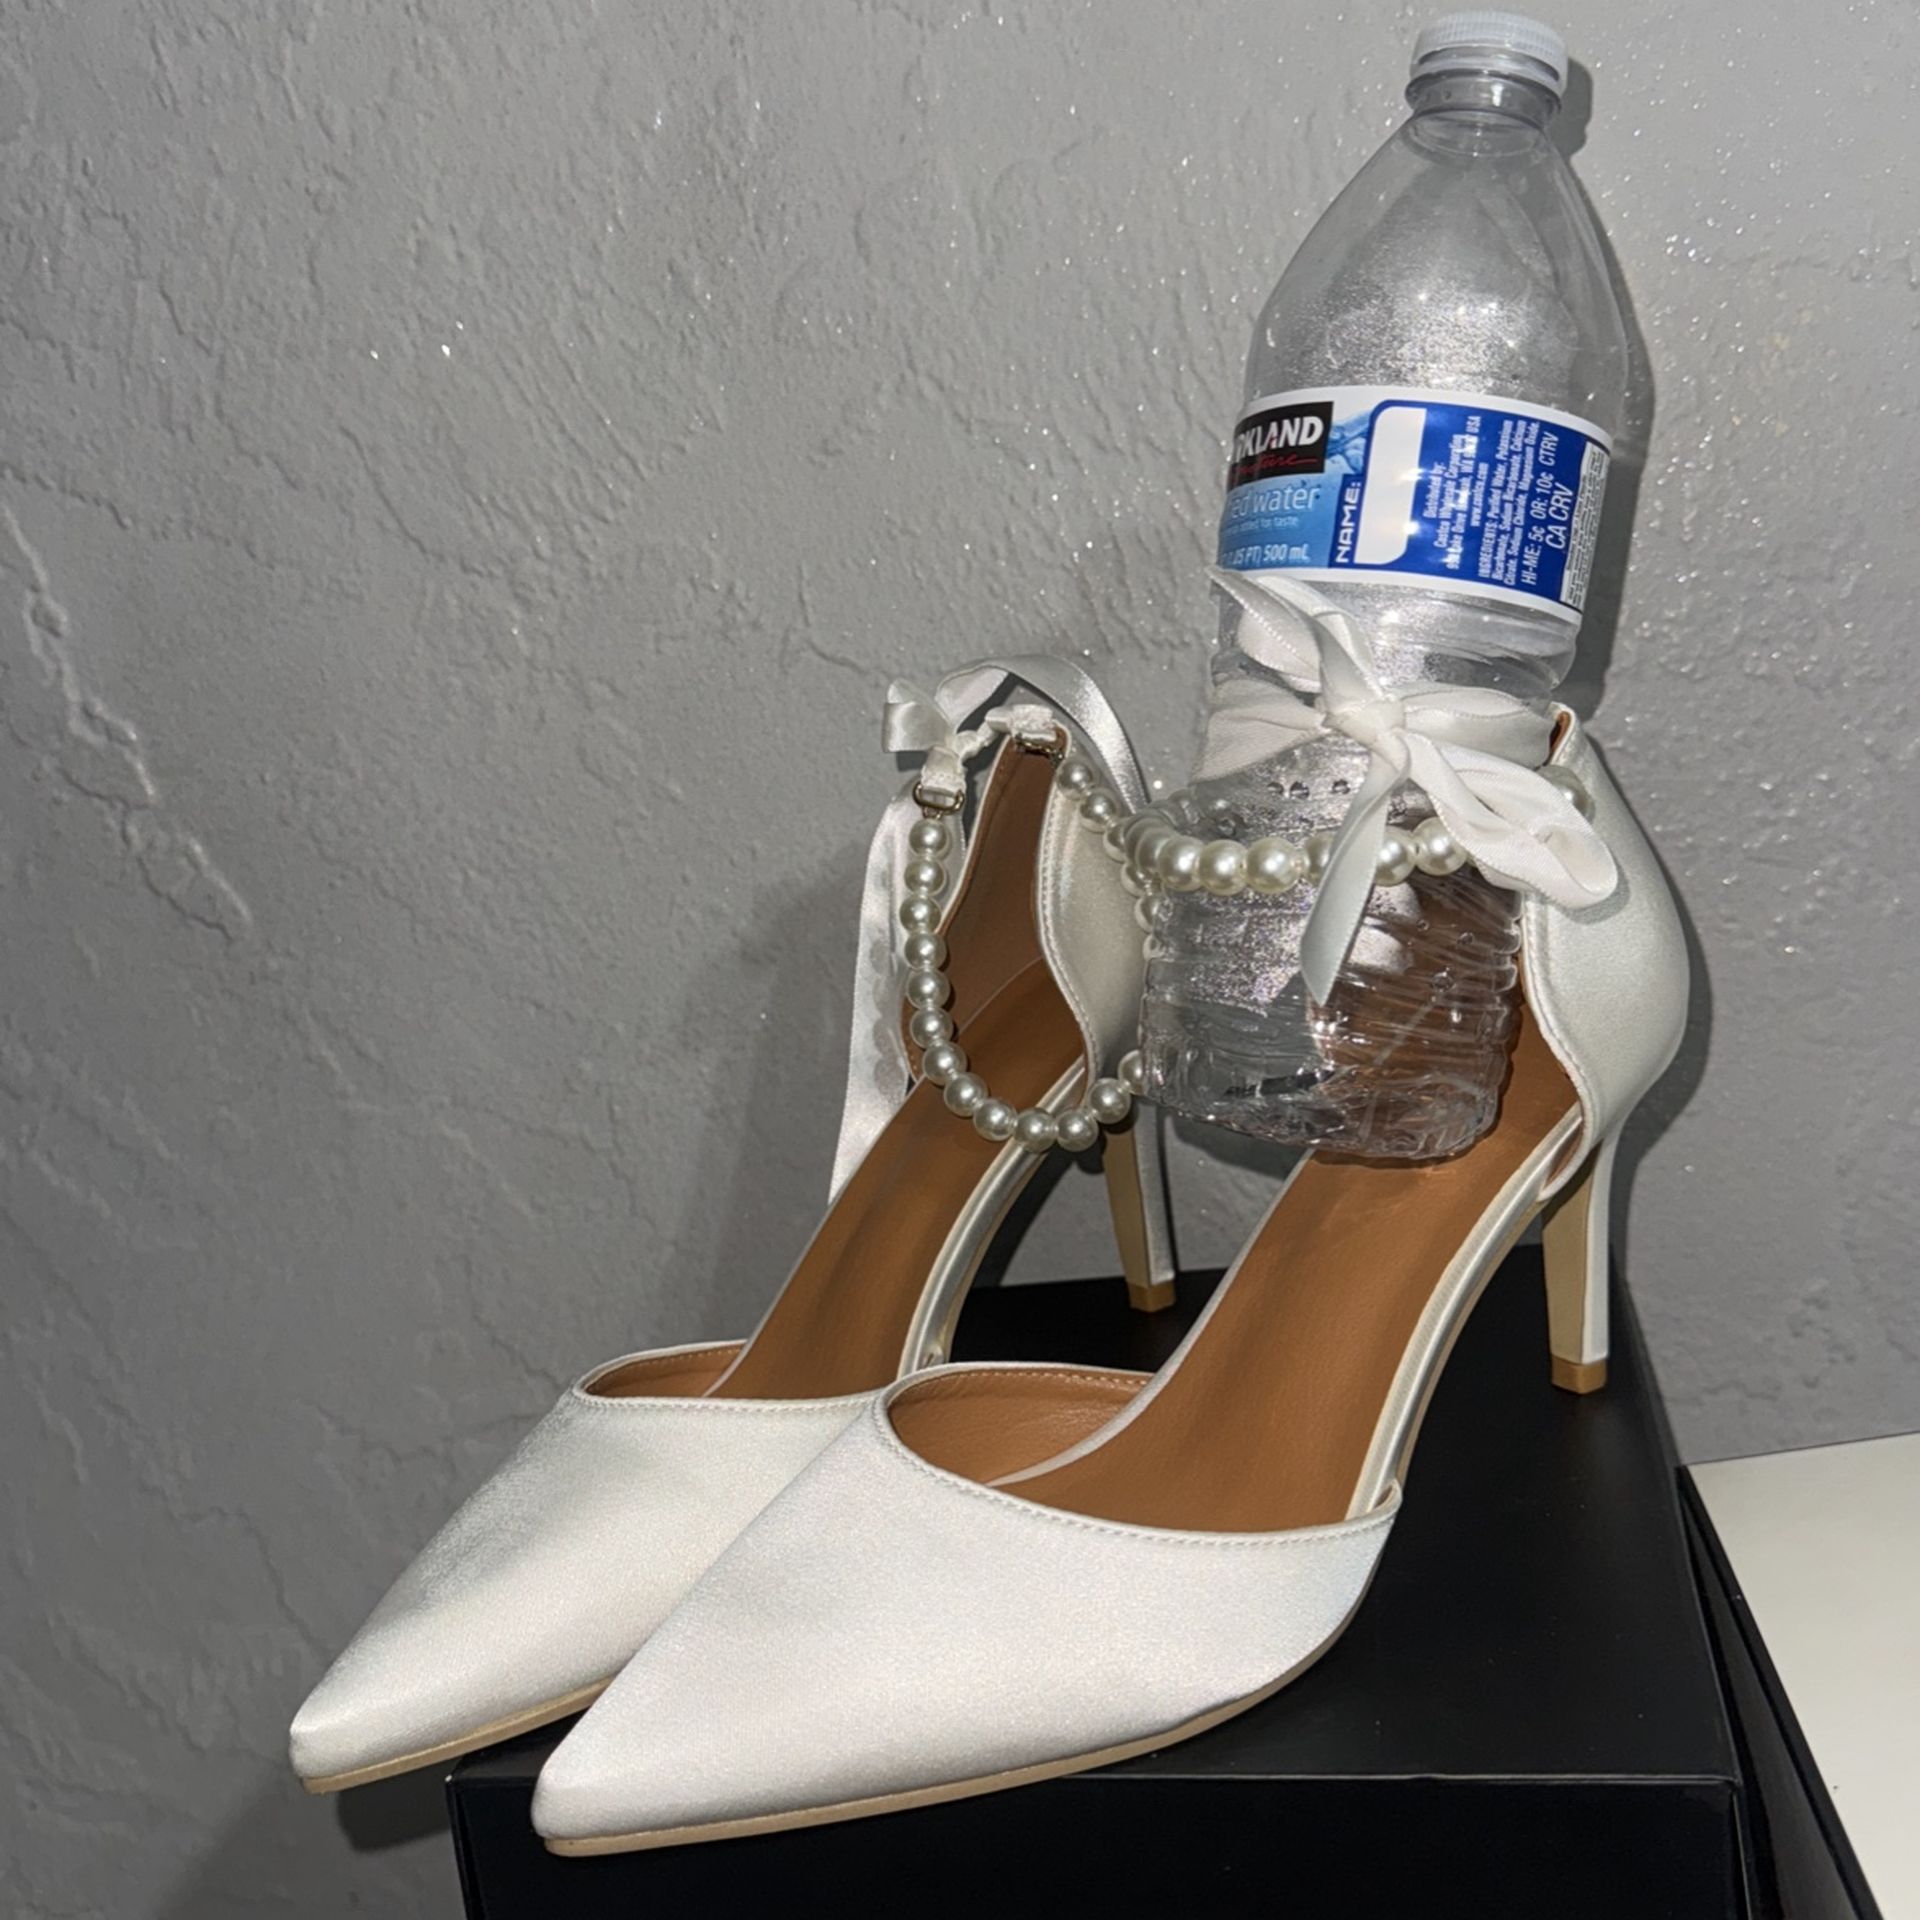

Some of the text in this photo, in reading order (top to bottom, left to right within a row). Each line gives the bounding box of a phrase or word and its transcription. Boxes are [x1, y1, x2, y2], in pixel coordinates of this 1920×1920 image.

[1538, 431, 1558, 465] CTRV
[1450, 512, 1466, 533] Drive
[1466, 415, 1480, 432] USA
[1498, 502, 1512, 531] Sodium
[1509, 420, 1526, 451] Calcium
[1253, 485, 1320, 514] water
[1423, 475, 1442, 517] Distributed
[1478, 522, 1497, 577] INGREDIENTS:
[1495, 420, 1512, 460] Potassium
[1529, 497, 1547, 519] OR:
[1545, 482, 1573, 548] CA CRV
[1336, 482, 1362, 563] NAME:
[1433, 520, 1450, 547] Costco
[1506, 526, 1522, 555] Sodium
[1263, 544, 1288, 562] 500
[1521, 543, 1540, 584] HI-ME:
